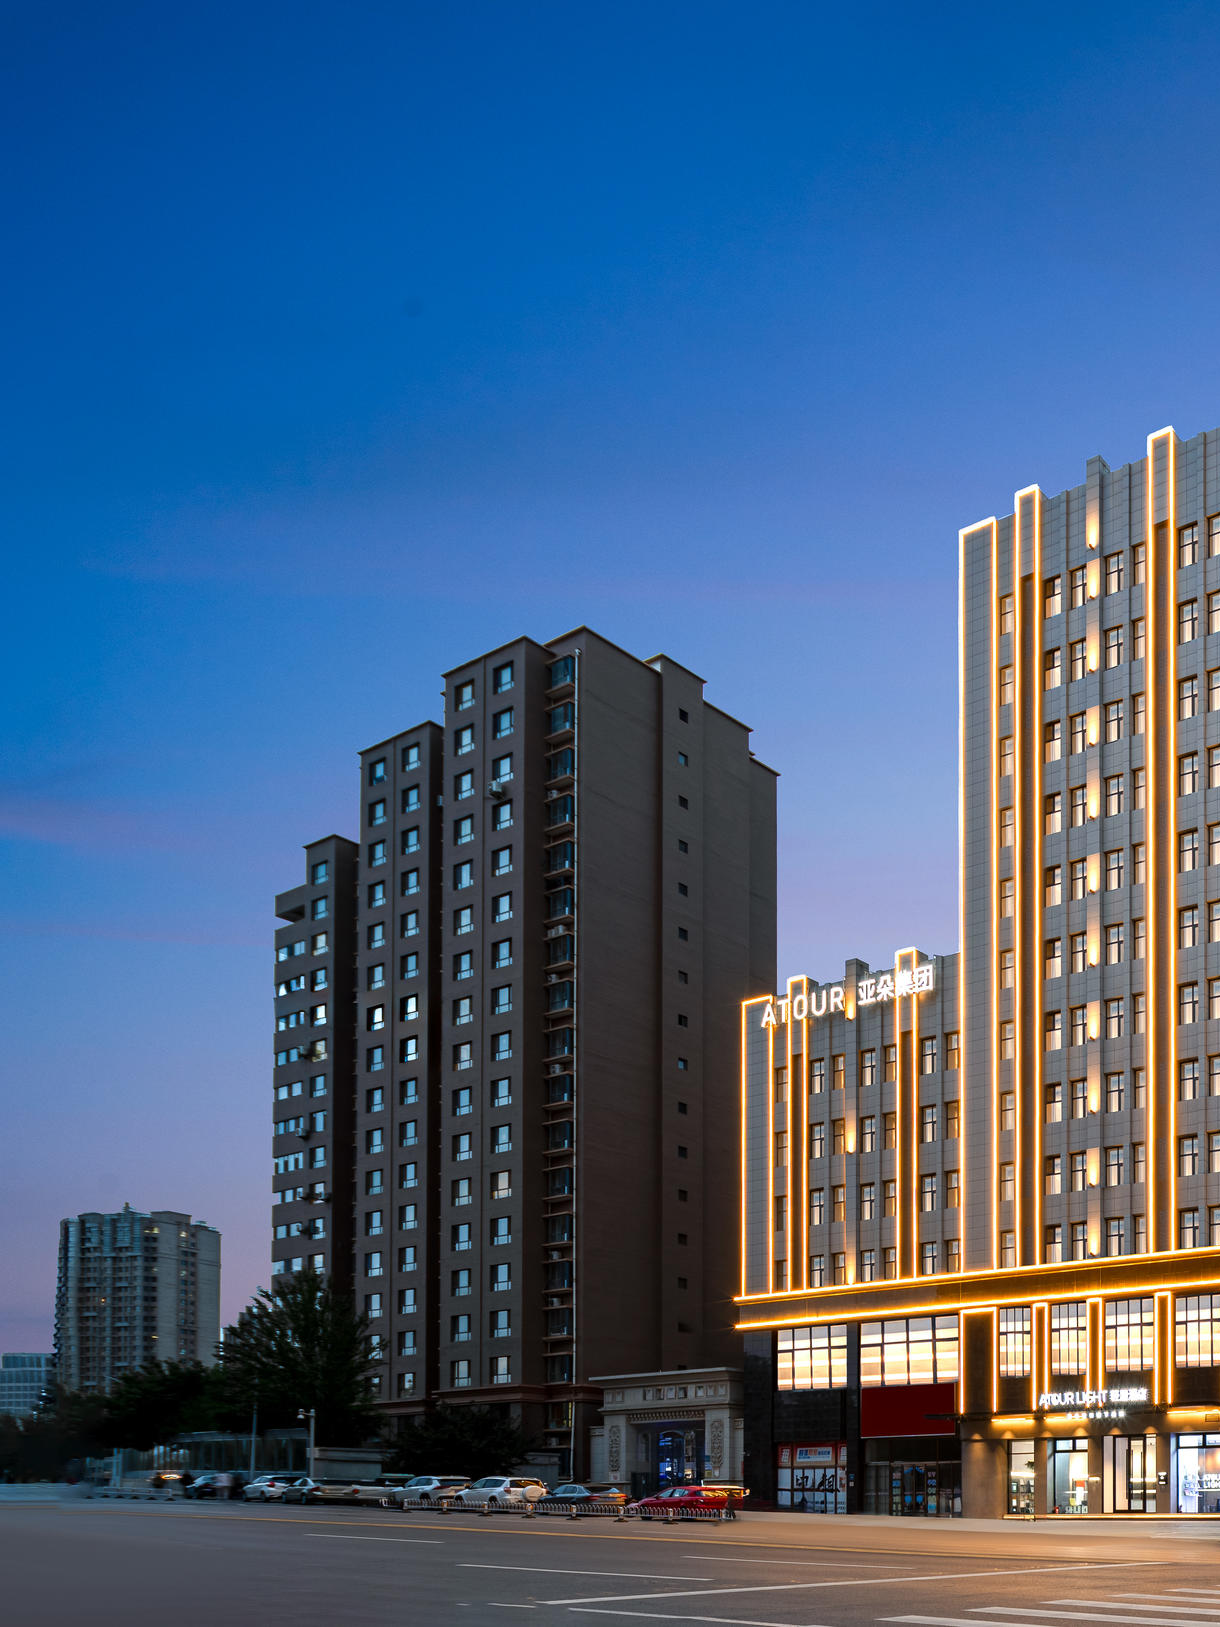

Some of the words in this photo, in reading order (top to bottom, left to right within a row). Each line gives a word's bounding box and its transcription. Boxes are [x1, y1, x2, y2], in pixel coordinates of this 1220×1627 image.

[761, 987, 845, 1027] ATOUR
[1039, 1392, 1074, 1406] ATOUR
[1076, 1390, 1107, 1404] LIGHT
